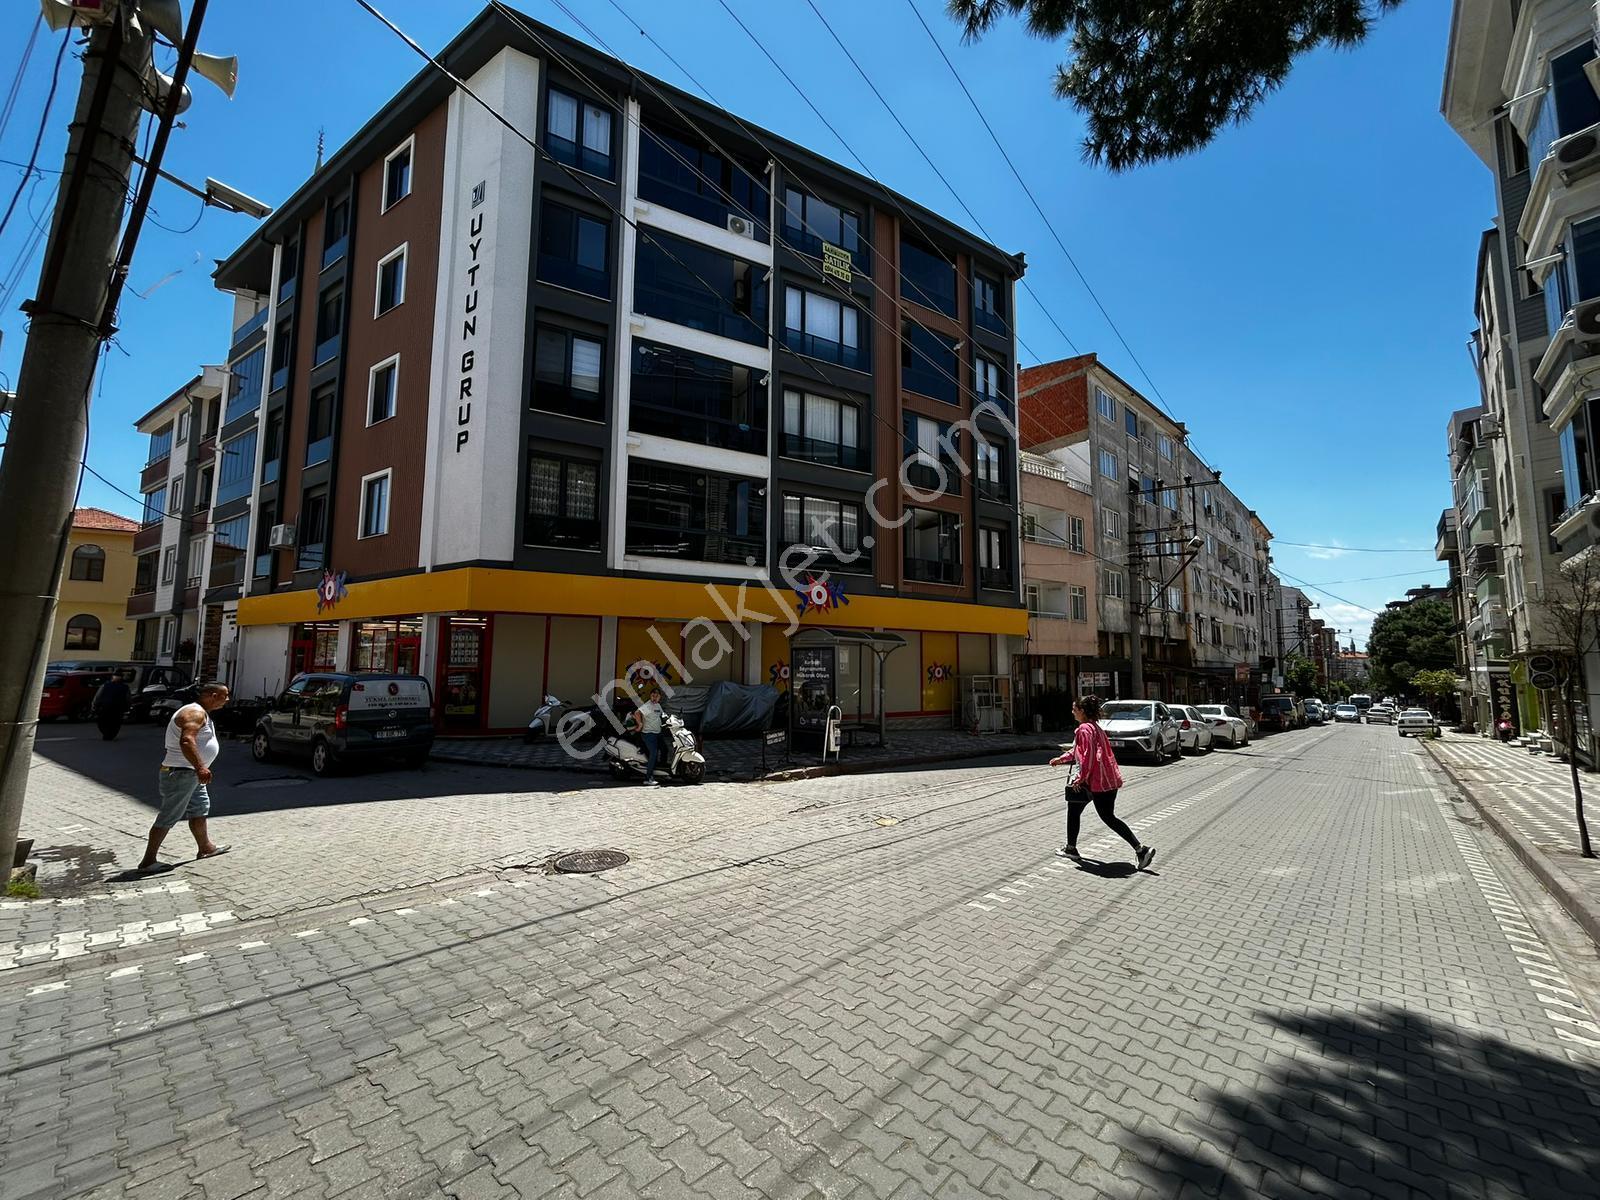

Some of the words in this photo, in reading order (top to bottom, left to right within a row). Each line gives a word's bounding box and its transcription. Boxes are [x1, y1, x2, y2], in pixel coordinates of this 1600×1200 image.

[463, 213, 483, 340] UYTUN
[456, 350, 475, 453] GRUP
[795, 574, 850, 617] ŞOK
